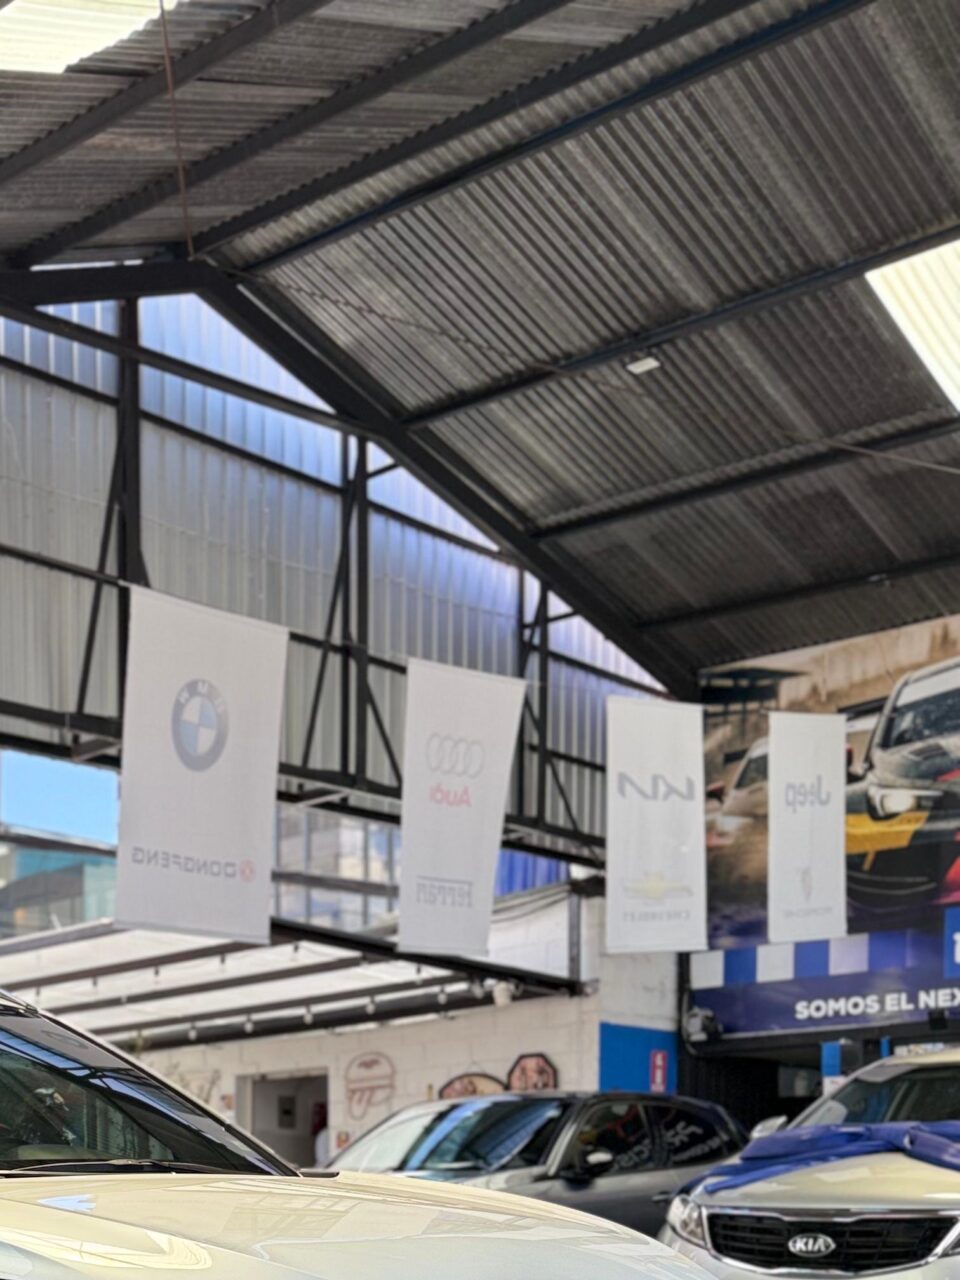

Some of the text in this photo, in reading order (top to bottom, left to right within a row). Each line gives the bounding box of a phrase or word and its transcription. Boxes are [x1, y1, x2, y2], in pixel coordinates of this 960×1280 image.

[795, 995, 880, 1020] SOMOS
[885, 992, 914, 1012] EL
[795, 1237, 826, 1251] KIA
